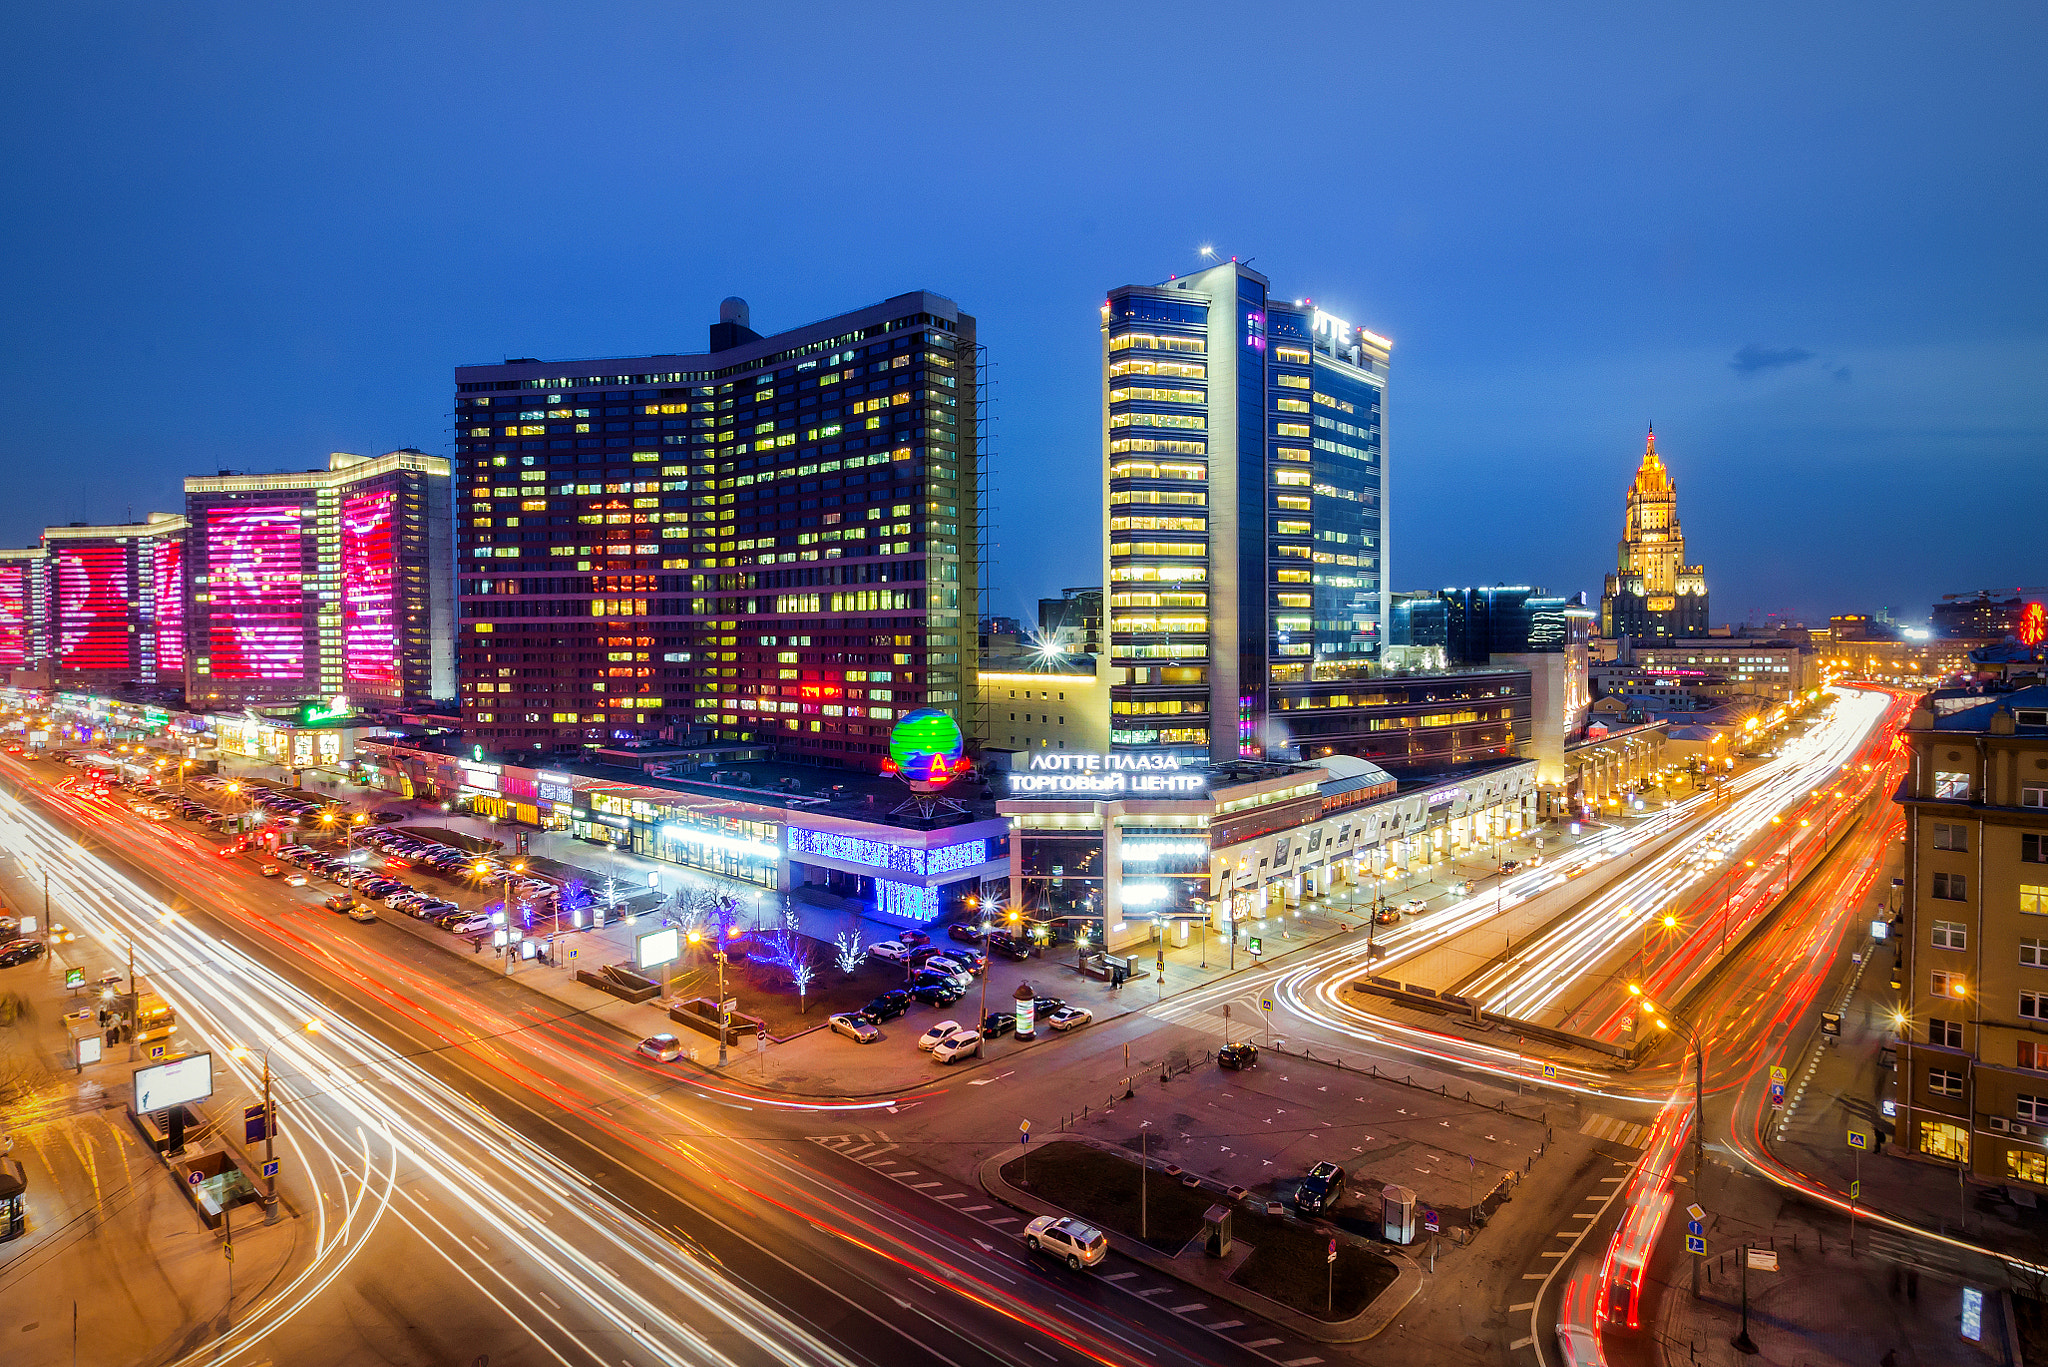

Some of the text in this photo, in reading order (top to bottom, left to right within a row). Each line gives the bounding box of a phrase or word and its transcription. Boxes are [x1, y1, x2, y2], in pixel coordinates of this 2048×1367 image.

[1030, 754, 1179, 770] ЛОТТЕ ПЛАЗА
[1009, 772, 1203, 791] ТОРГОВЫЙ ЦЕНТР
